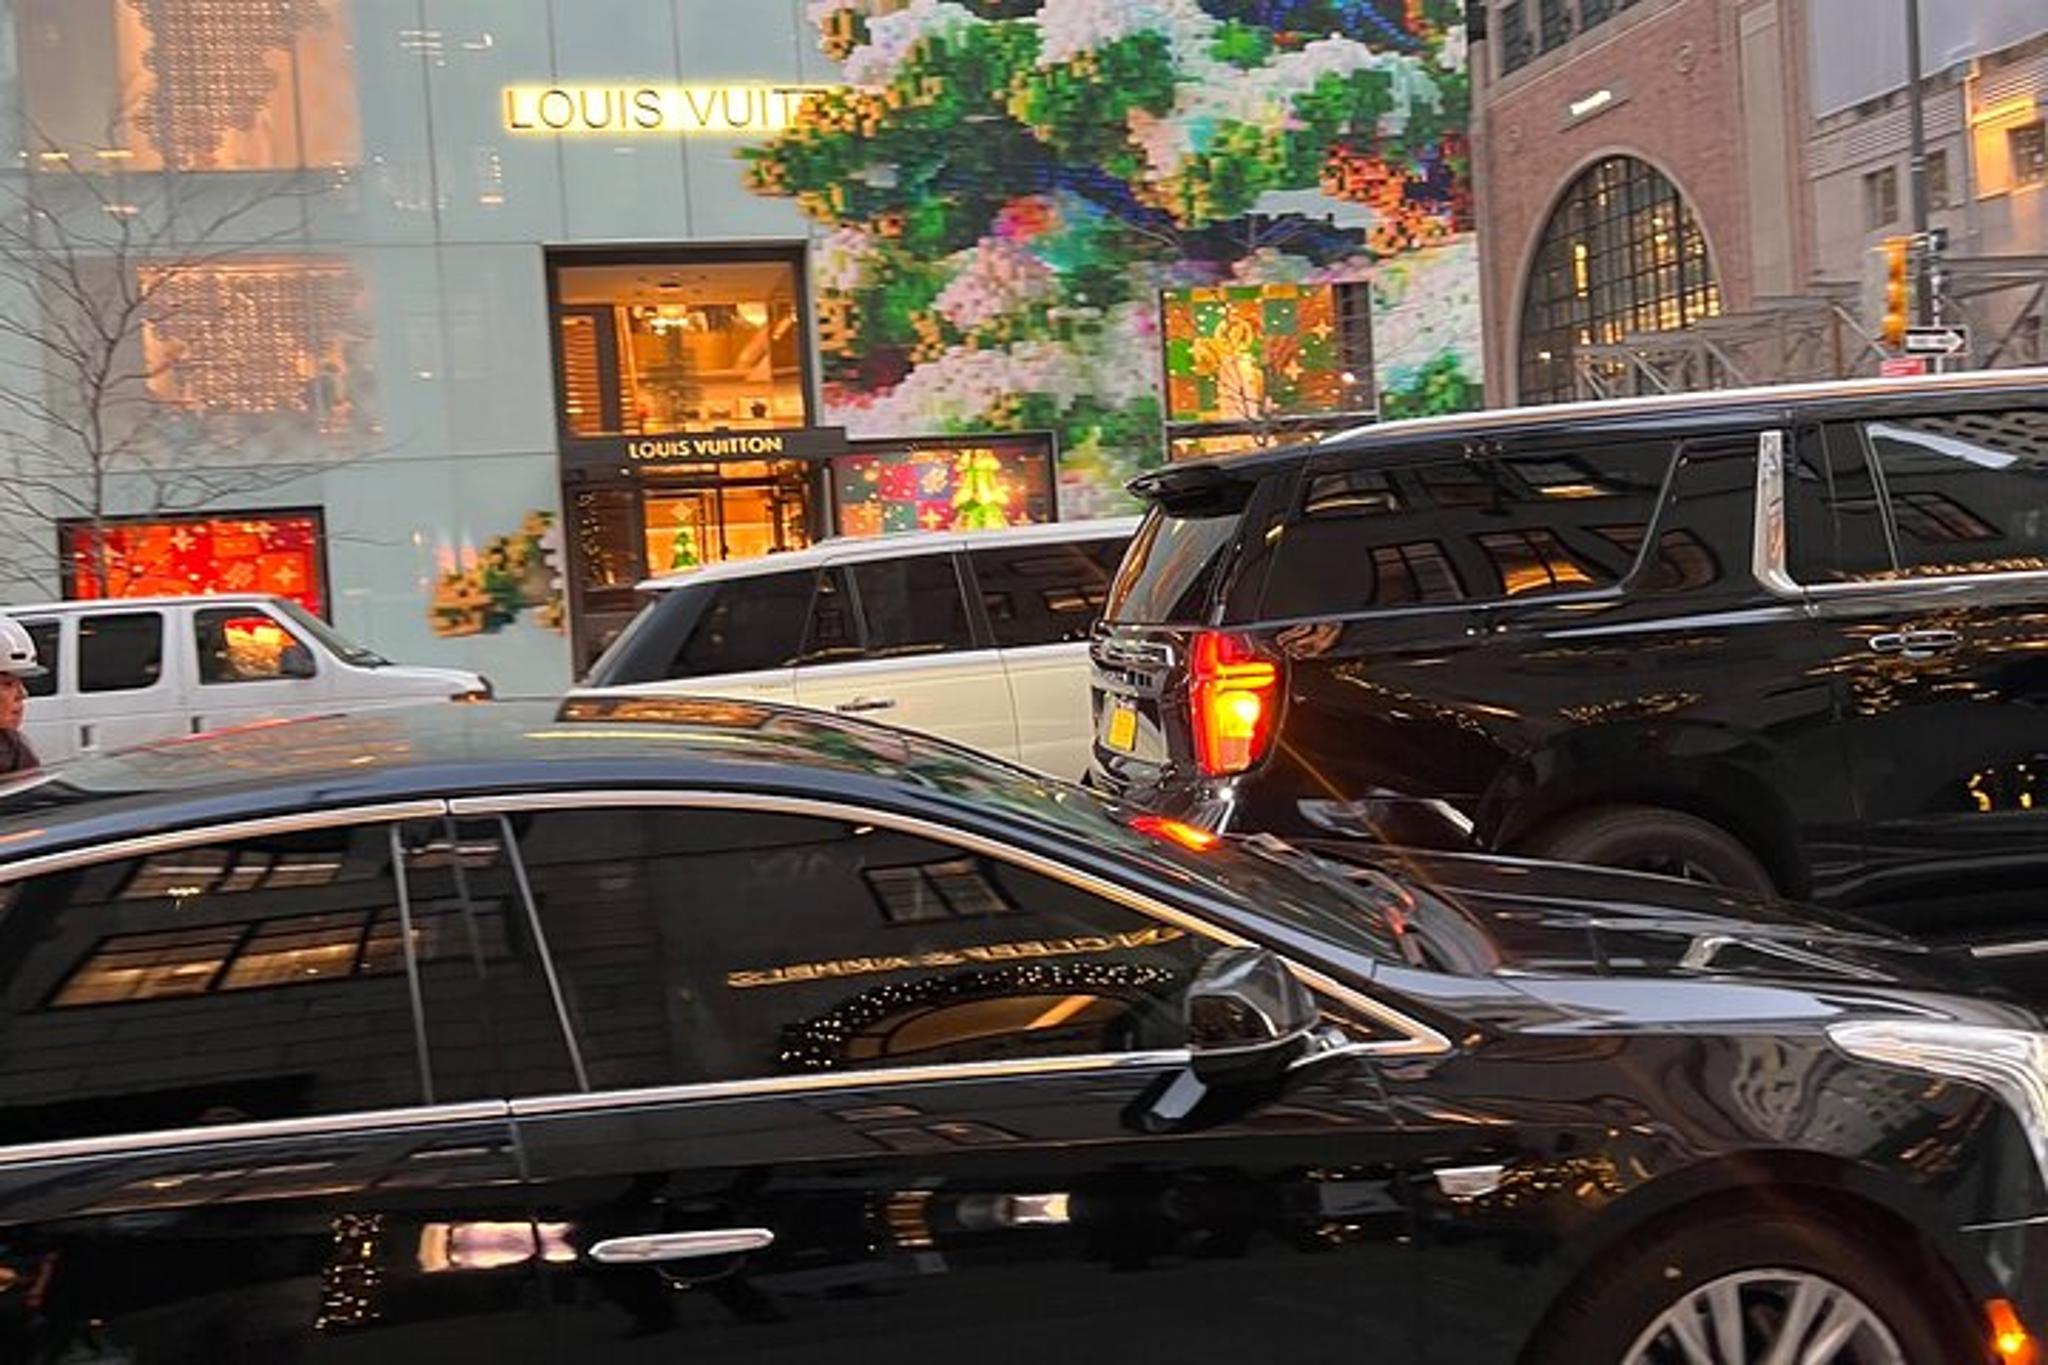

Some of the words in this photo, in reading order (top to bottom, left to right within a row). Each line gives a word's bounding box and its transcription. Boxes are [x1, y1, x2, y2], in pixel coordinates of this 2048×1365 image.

[505, 89, 664, 129] LOUIS
[628, 439, 690, 459] LOUIS
[693, 436, 783, 455] VUITTON
